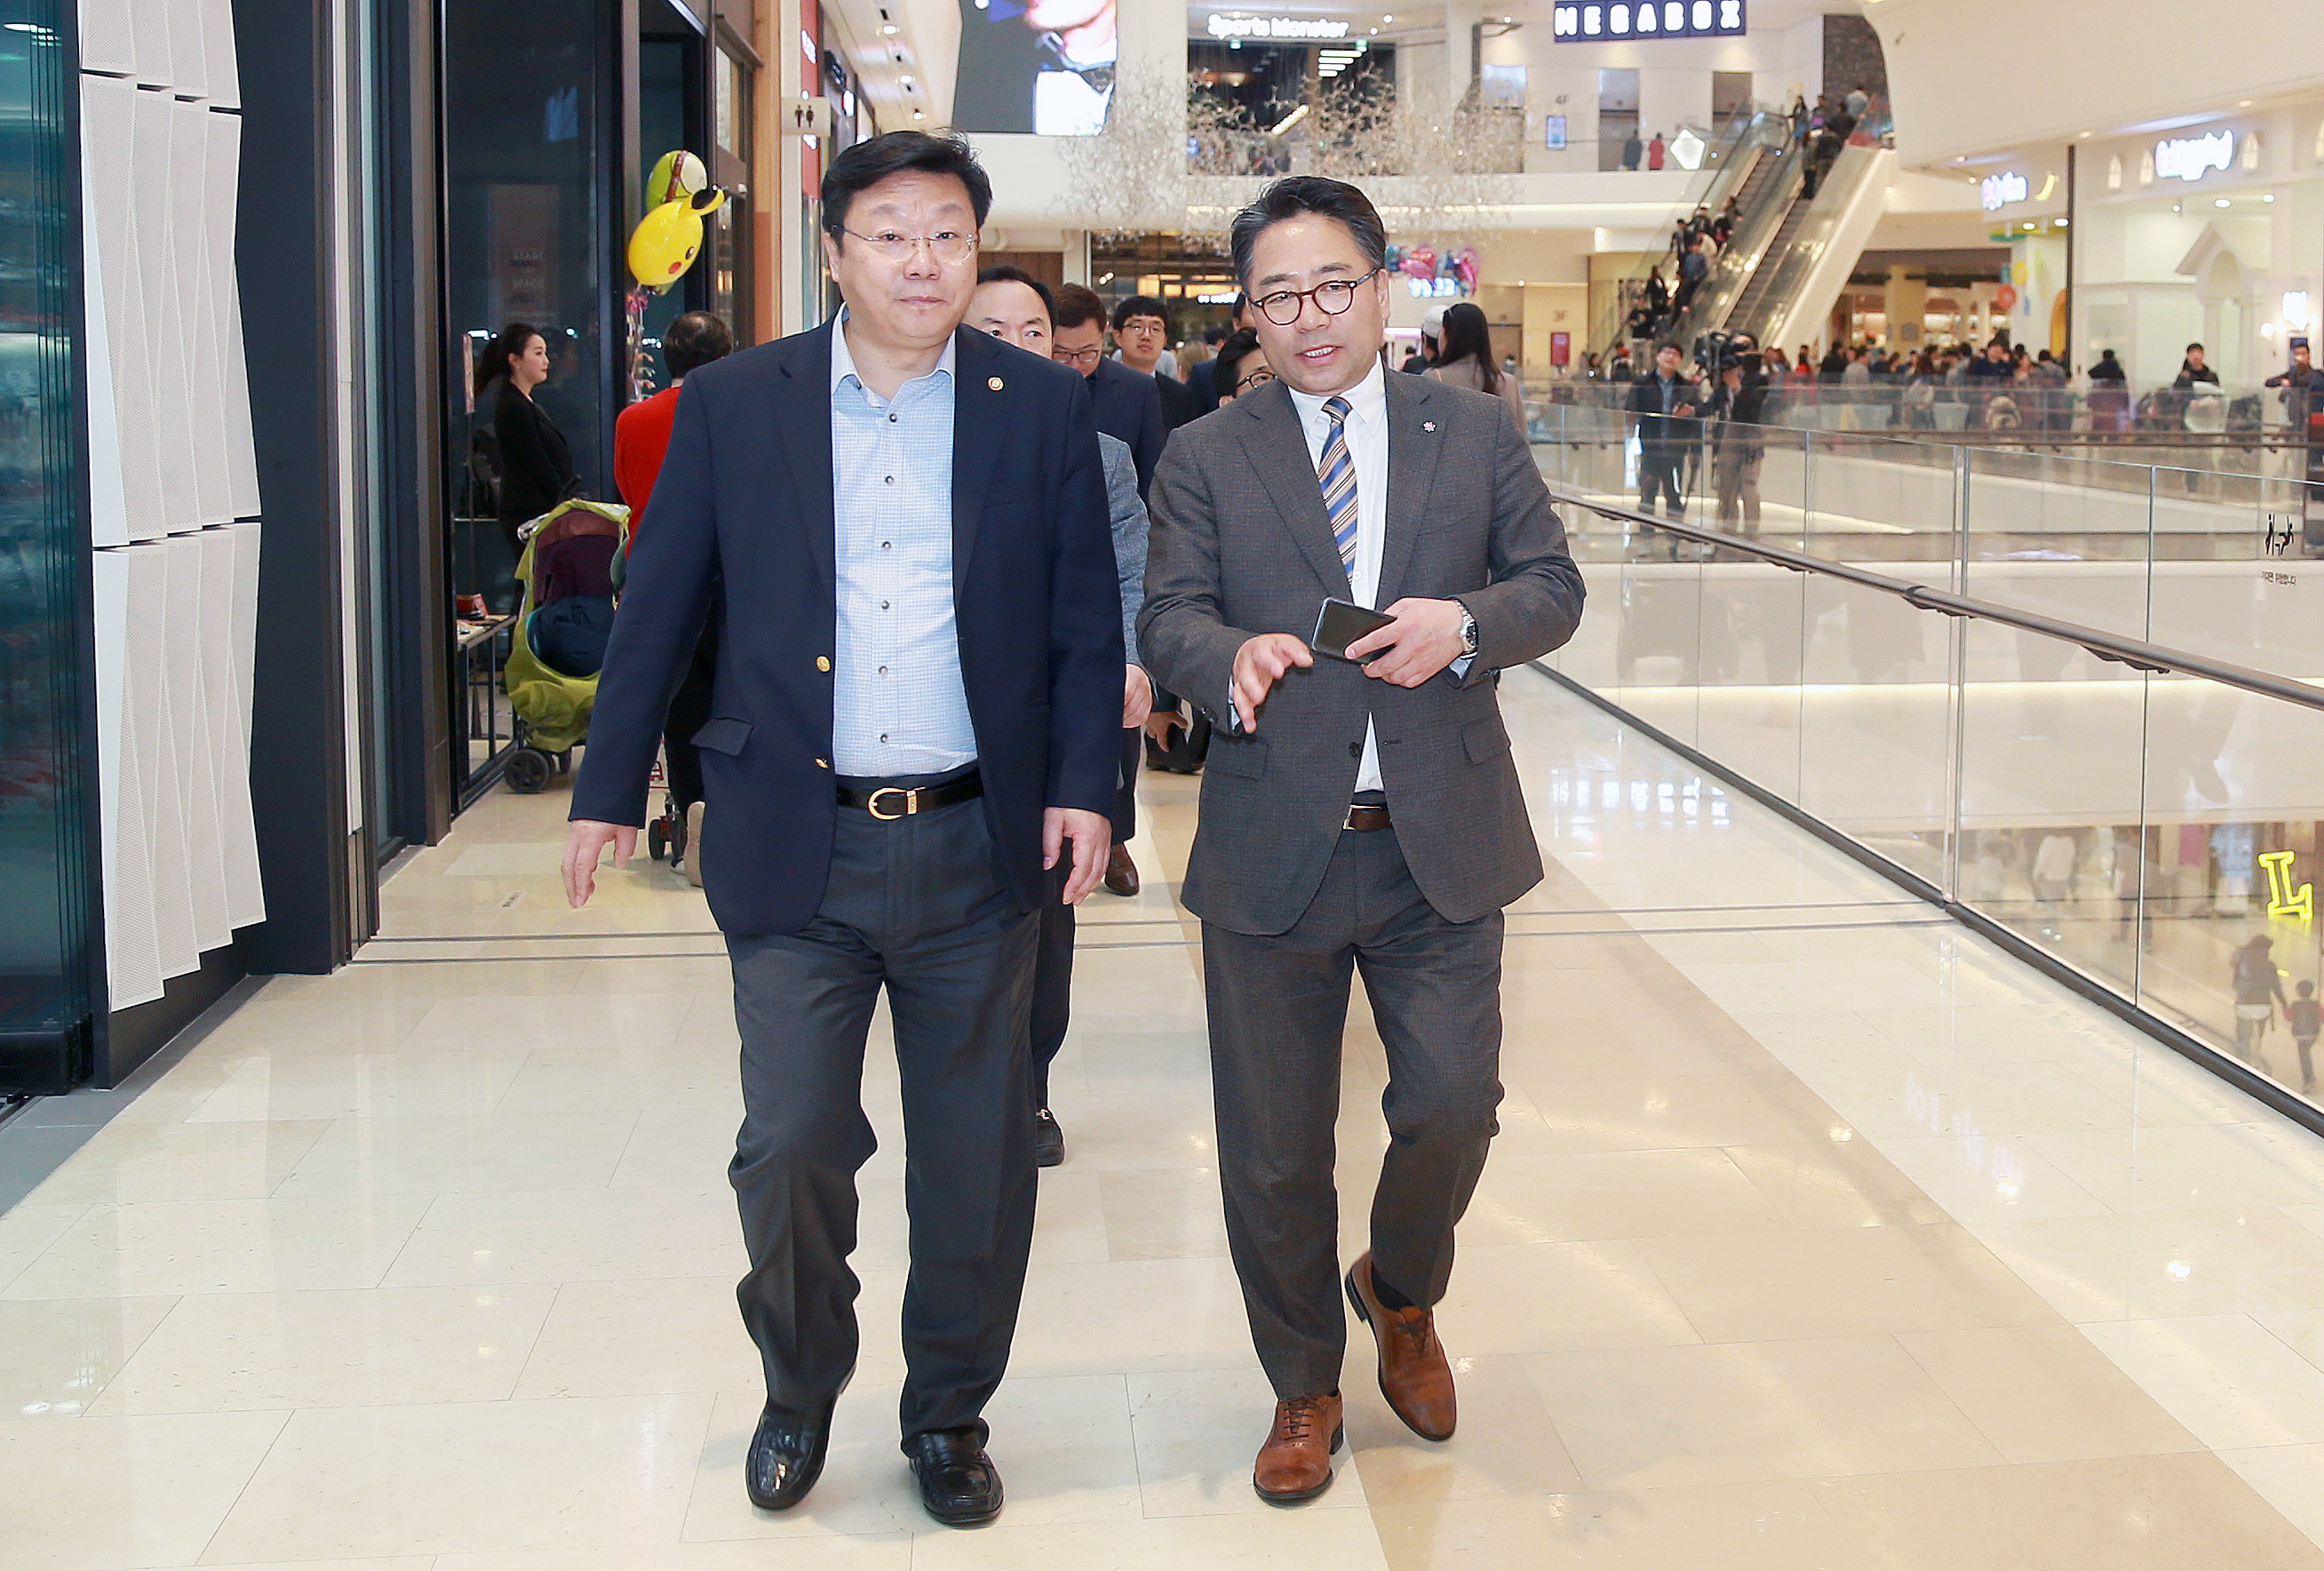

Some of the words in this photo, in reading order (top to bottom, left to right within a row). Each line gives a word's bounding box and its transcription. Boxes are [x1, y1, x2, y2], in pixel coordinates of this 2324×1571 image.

[1207, 14, 1270, 40] Sports
[1271, 17, 1349, 38] Monster
[1555, 0, 1740, 36] MEGABOX
